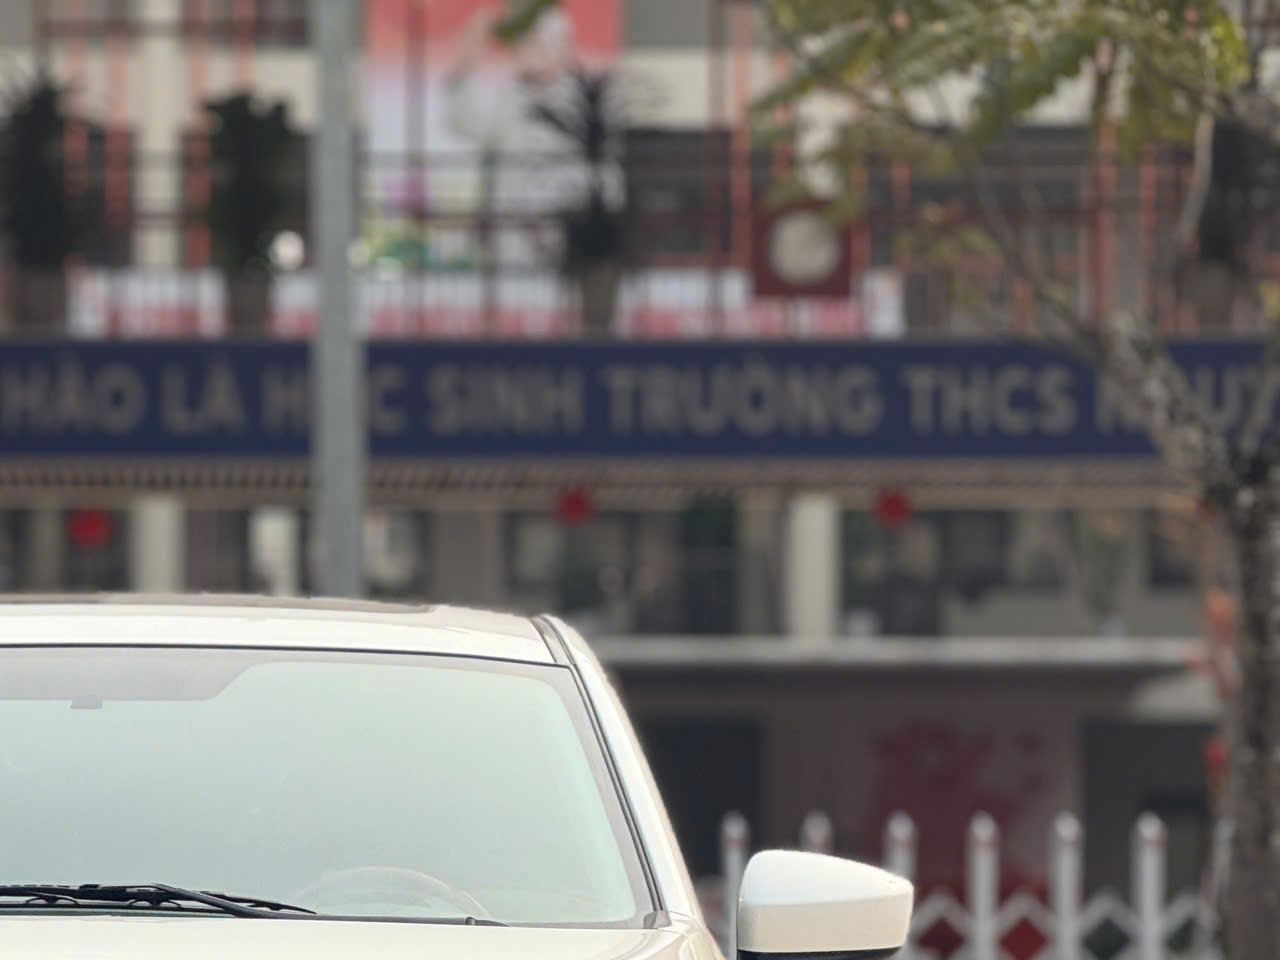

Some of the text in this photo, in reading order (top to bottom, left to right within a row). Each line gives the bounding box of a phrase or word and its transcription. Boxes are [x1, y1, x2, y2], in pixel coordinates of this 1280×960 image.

[0, 347, 146, 434] HÀO
[160, 347, 247, 434] LÀ
[261, 365, 407, 435] HC
[428, 363, 580, 434] SINH
[901, 363, 1077, 436] THCS
